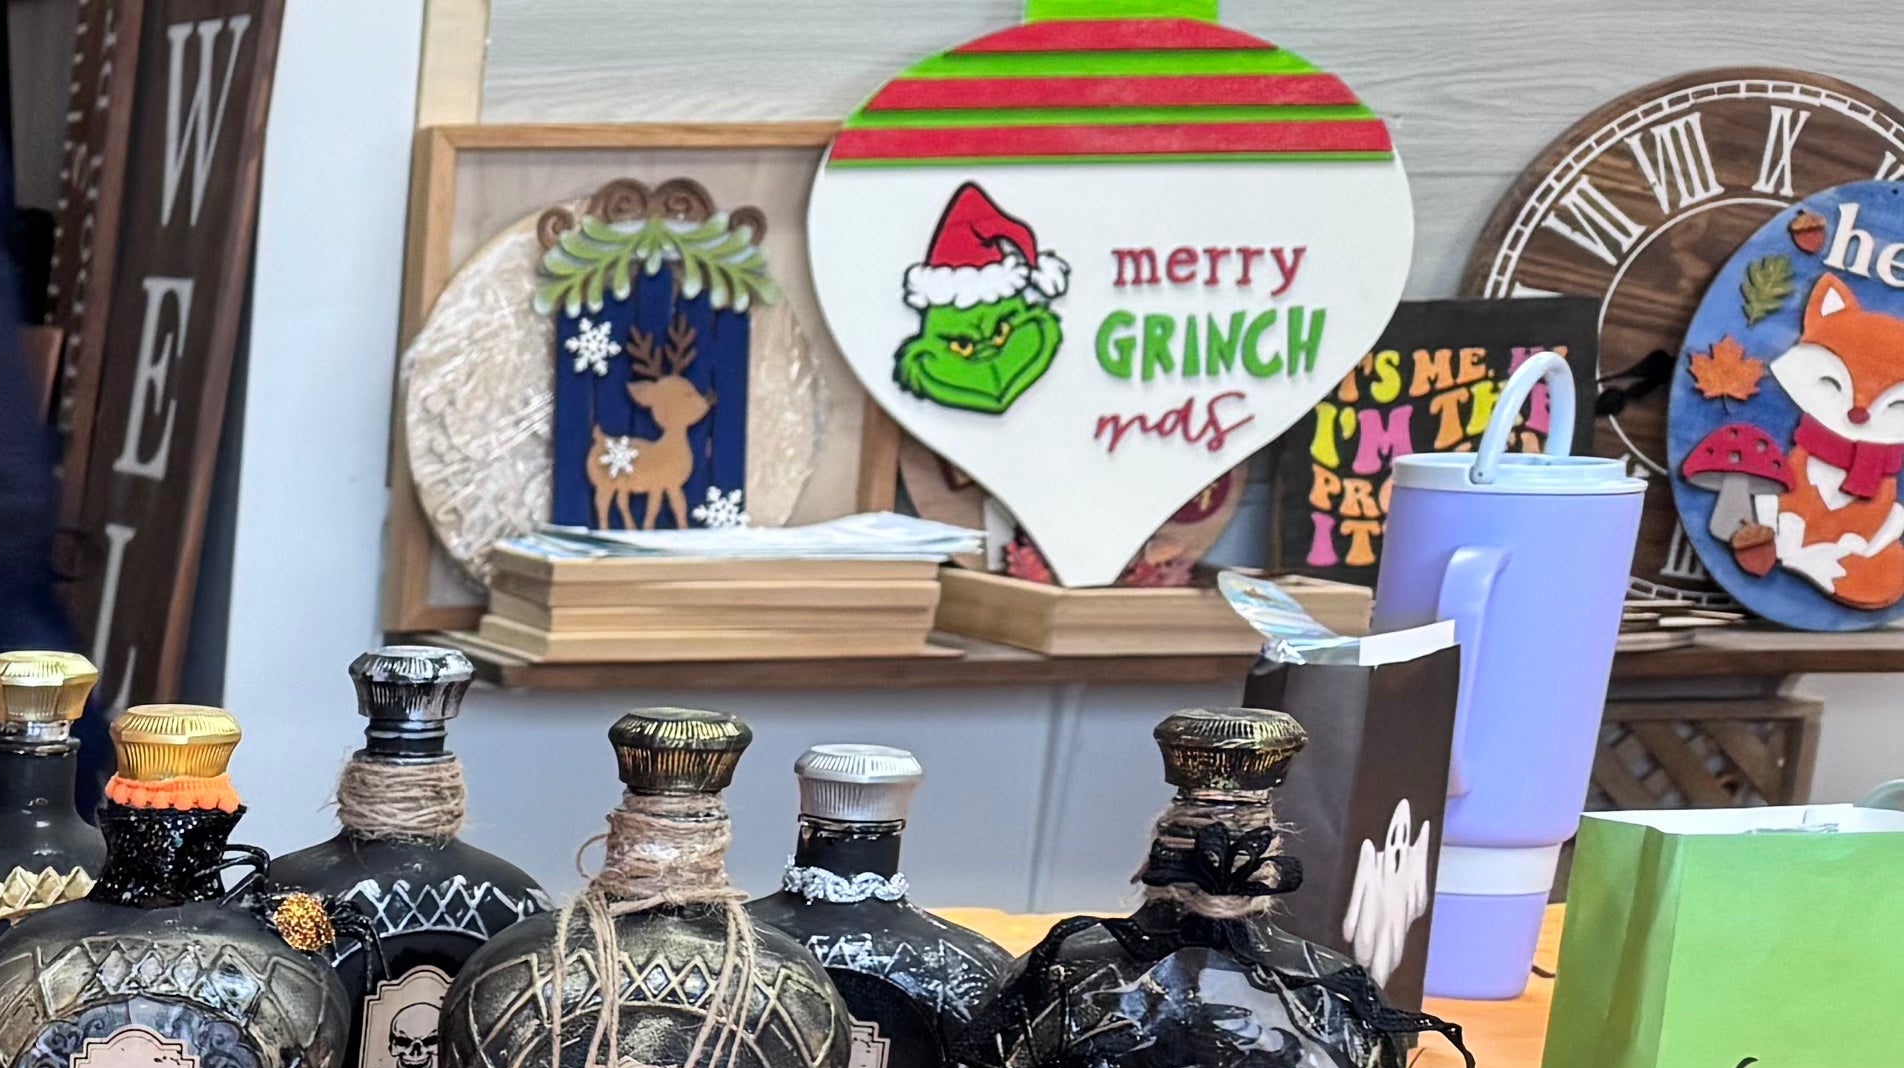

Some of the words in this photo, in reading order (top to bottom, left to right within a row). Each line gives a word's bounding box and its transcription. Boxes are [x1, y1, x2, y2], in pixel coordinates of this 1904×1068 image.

[1753, 105, 1811, 197] IX
[1111, 245, 1307, 297] merry
[1095, 305, 1327, 381] GRINCH
[1093, 391, 1255, 454] mas
[1310, 401, 1413, 475] I'M
